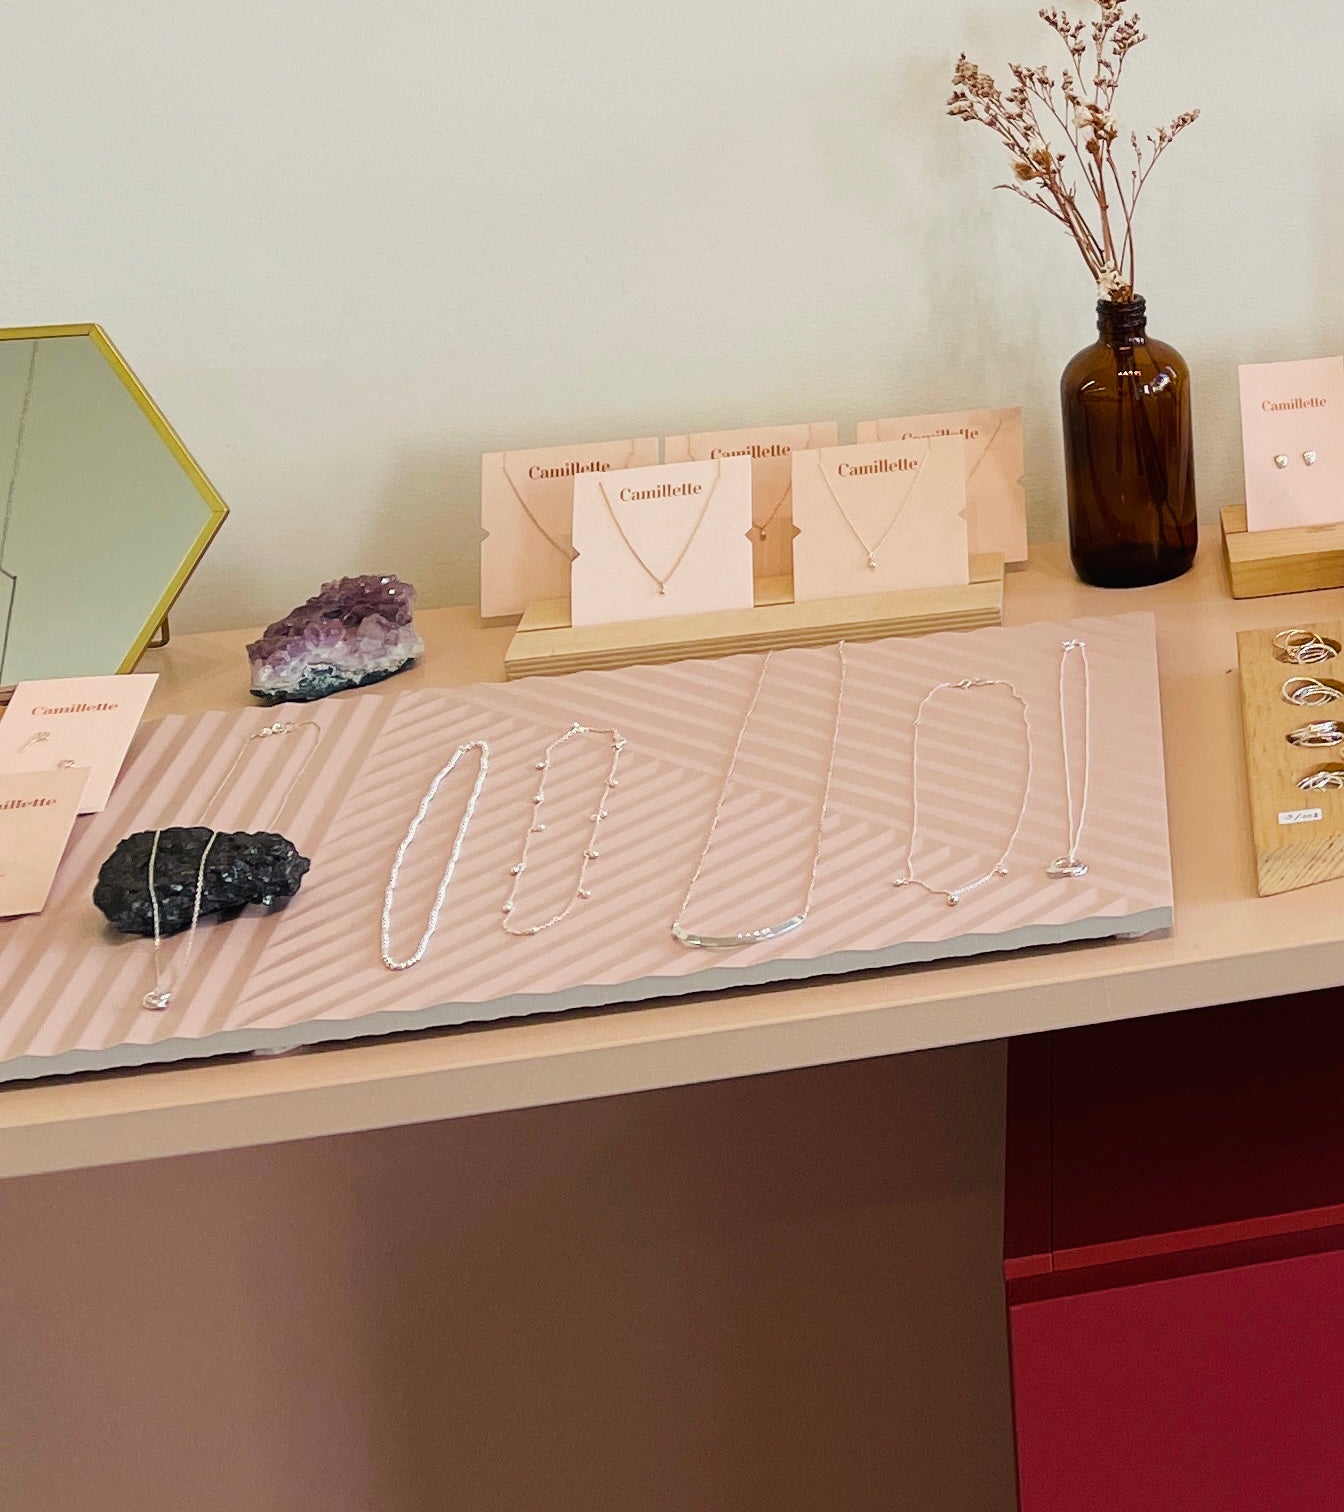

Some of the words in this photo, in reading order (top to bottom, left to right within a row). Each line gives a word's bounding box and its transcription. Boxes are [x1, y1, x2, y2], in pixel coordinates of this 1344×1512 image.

[1261, 397, 1327, 412] Camillette
[528, 461, 611, 479] Camillette
[838, 458, 918, 478] Camillette
[620, 483, 702, 502] Camillette
[31, 703, 119, 716] Camillette
[0, 798, 57, 810] illette
